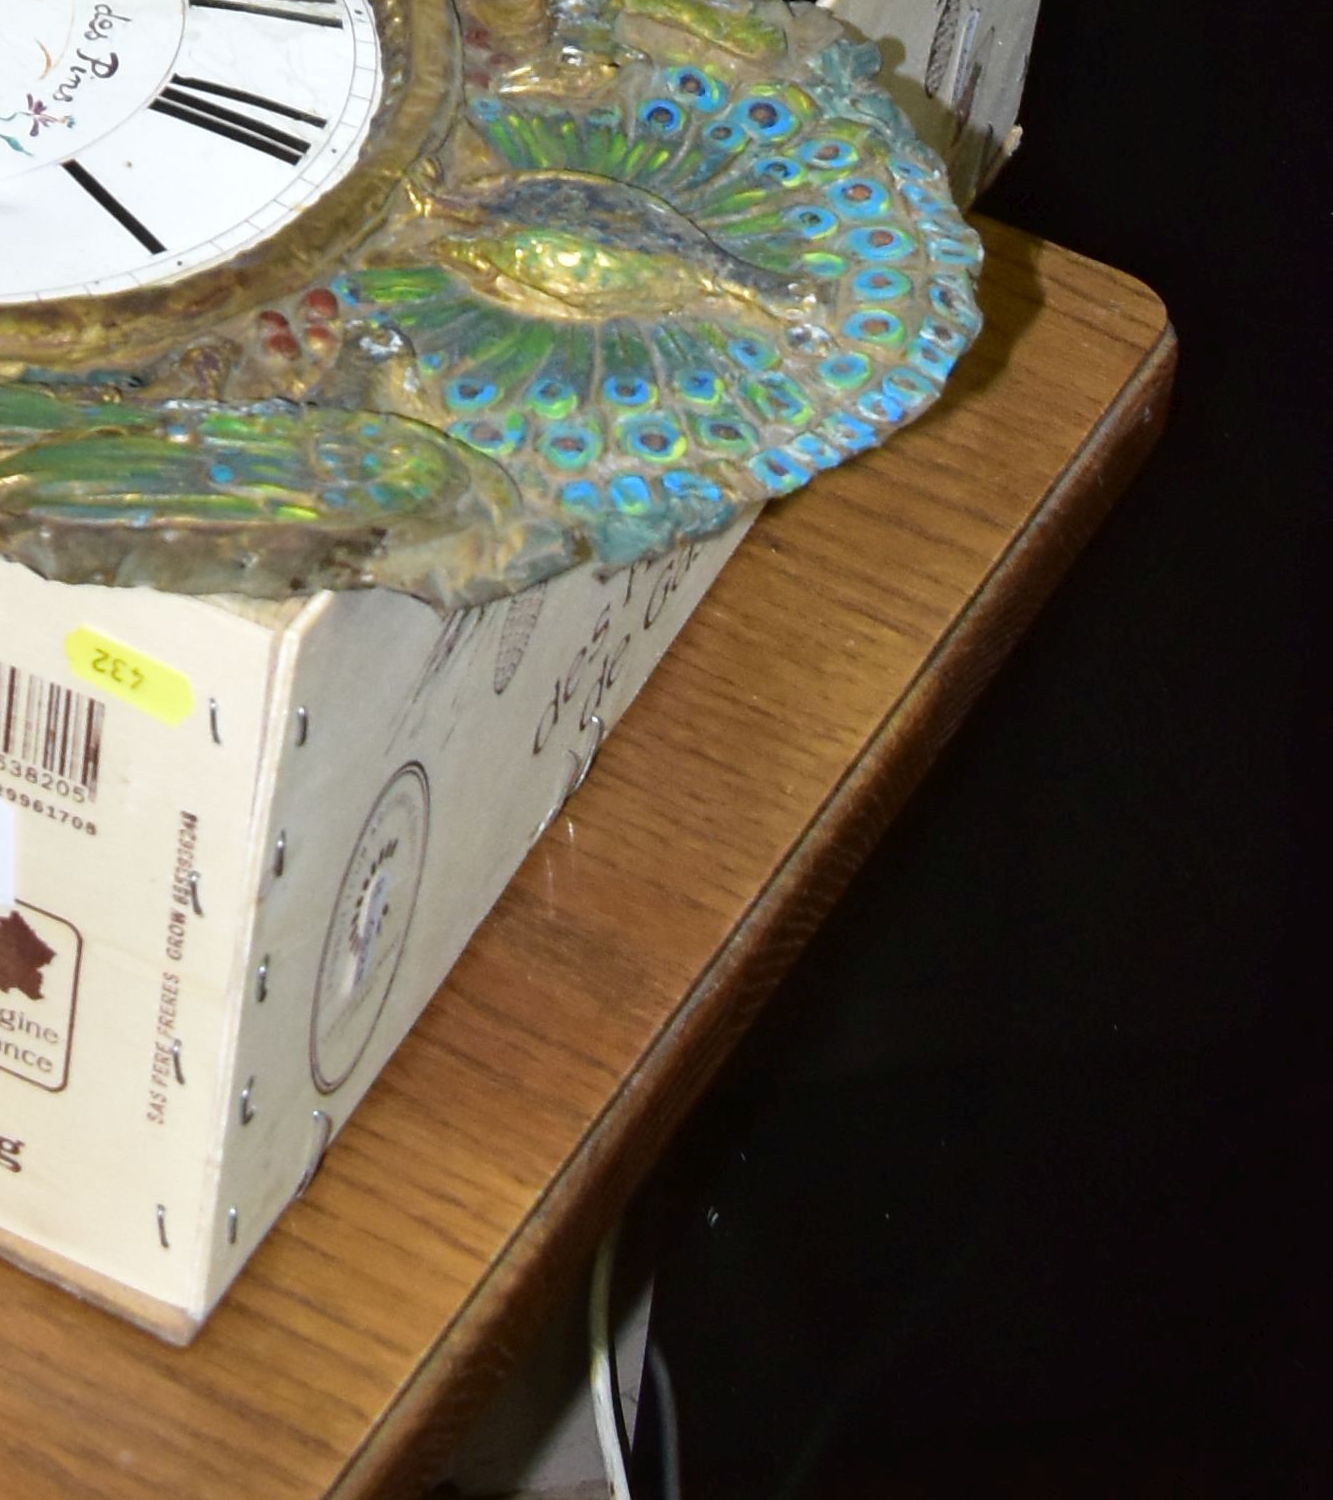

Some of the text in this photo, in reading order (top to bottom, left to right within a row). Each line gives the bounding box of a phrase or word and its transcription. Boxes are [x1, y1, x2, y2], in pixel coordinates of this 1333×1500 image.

[84, 3, 133, 41] des
[53, 48, 119, 102] Pins
[90, 647, 145, 690] 432
[165, 908, 188, 961] GROW
[157, 972, 181, 1041] FRERES
[146, 1089, 168, 1126] SAS
